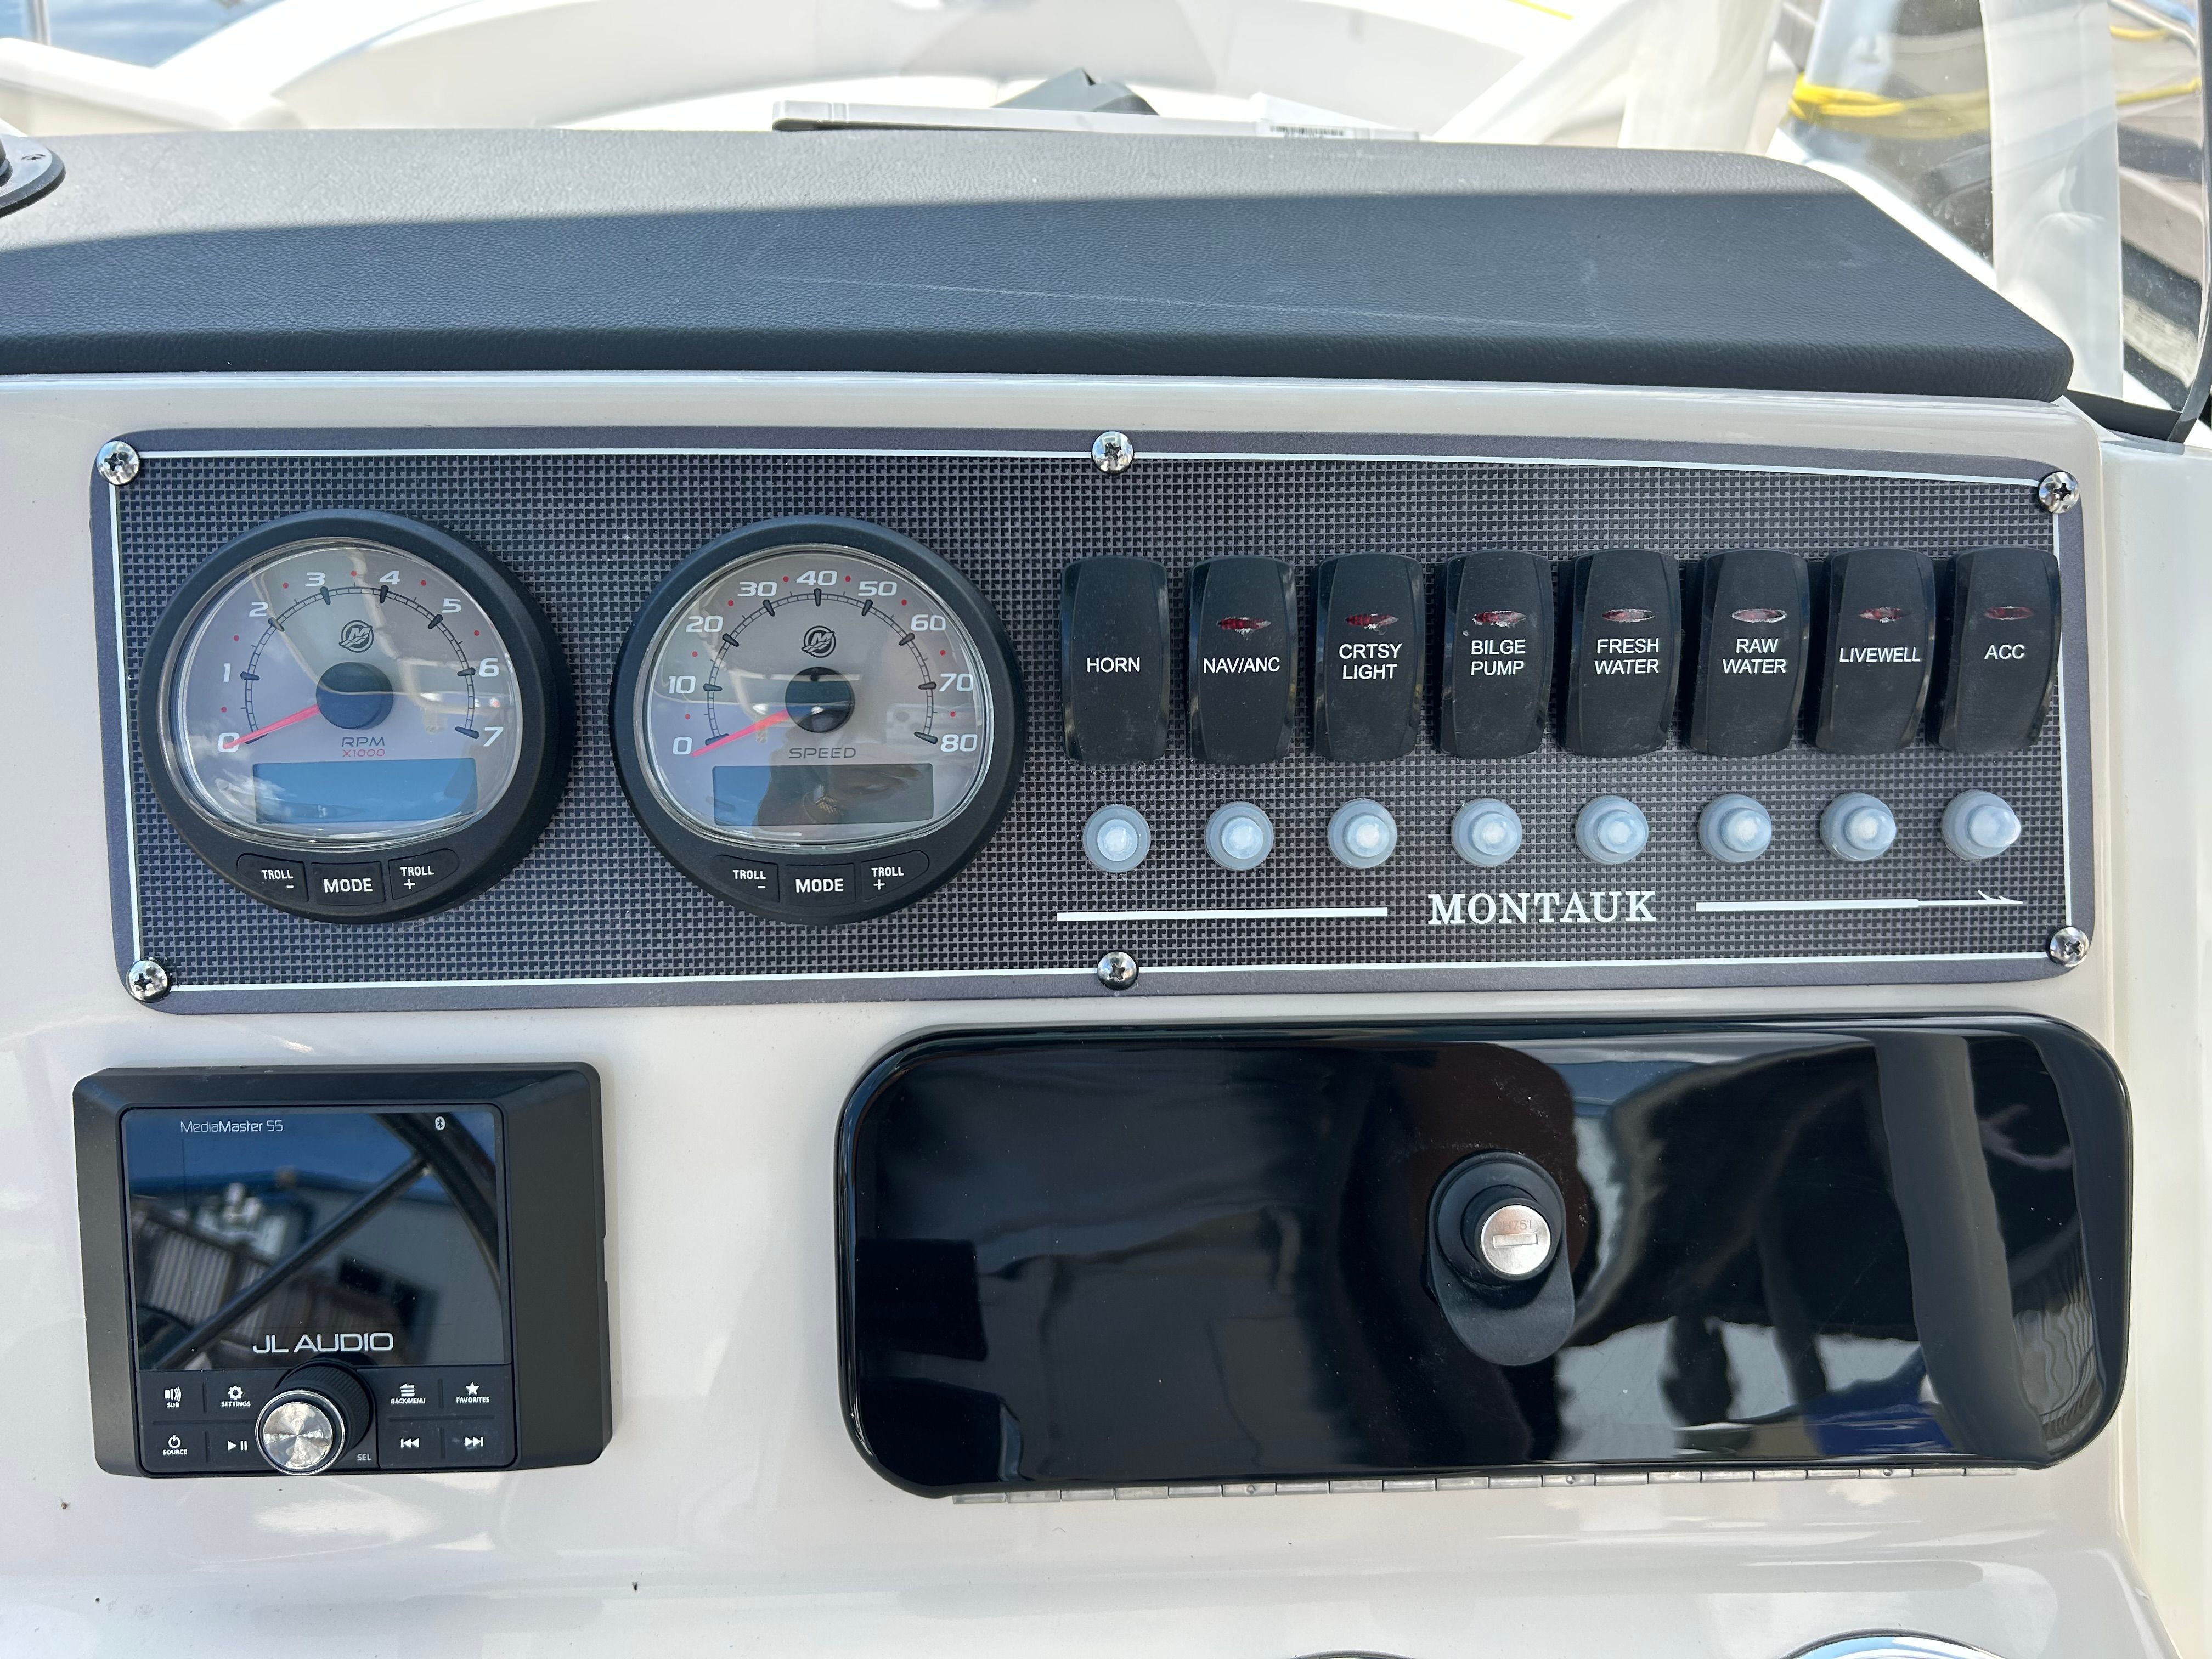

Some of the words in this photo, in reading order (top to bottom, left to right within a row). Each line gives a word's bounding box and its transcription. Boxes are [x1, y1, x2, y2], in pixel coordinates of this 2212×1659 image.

[305, 572, 326, 586] 3
[380, 571, 400, 585] 4
[796, 571, 837, 586] 40
[737, 582, 778, 597] 30
[858, 581, 898, 596] 50
[249, 602, 268, 617] 2
[442, 598, 462, 613] 5
[685, 617, 724, 632] 20
[910, 614, 946, 631] 60
[1338, 642, 1402, 659] CRTSY
[1470, 639, 1527, 656] BILGE
[1596, 638, 1660, 654] FRESH
[1736, 638, 1779, 653] RAW
[1984, 644, 2025, 660] ACC
[1839, 647, 1921, 663] LIVEWELL
[479, 658, 499, 677] 6
[1086, 657, 1141, 673] HORN
[1203, 657, 1280, 674] NAV/ANC
[1342, 663, 1398, 680] LIGHT
[1470, 660, 1525, 676] PUMP
[1594, 659, 1660, 675] WATER
[1722, 659, 1787, 674] WATER
[222, 664, 230, 682] 1
[668, 675, 696, 695] 10
[939, 674, 974, 692] 70
[218, 733, 240, 752] 0
[341, 736, 386, 747] RPM
[483, 727, 504, 747] 7
[940, 735, 978, 752] 80
[342, 748, 386, 757] X1000
[673, 737, 692, 755] 0
[789, 747, 856, 759] SPEED
[261, 869, 294, 880] TROLL
[400, 866, 435, 877] TROLL
[733, 869, 766, 880] TROLL
[872, 866, 904, 877] TROLL
[324, 878, 373, 893] MODE
[795, 878, 844, 893] MODE
[1427, 891, 1657, 924] MONTAUK
[180, 1120, 263, 1133] MediaMaster
[267, 1120, 284, 1132] 55
[253, 1334, 289, 1354] JL
[294, 1332, 394, 1353] AUDIO
[357, 1453, 372, 1462] SEL
